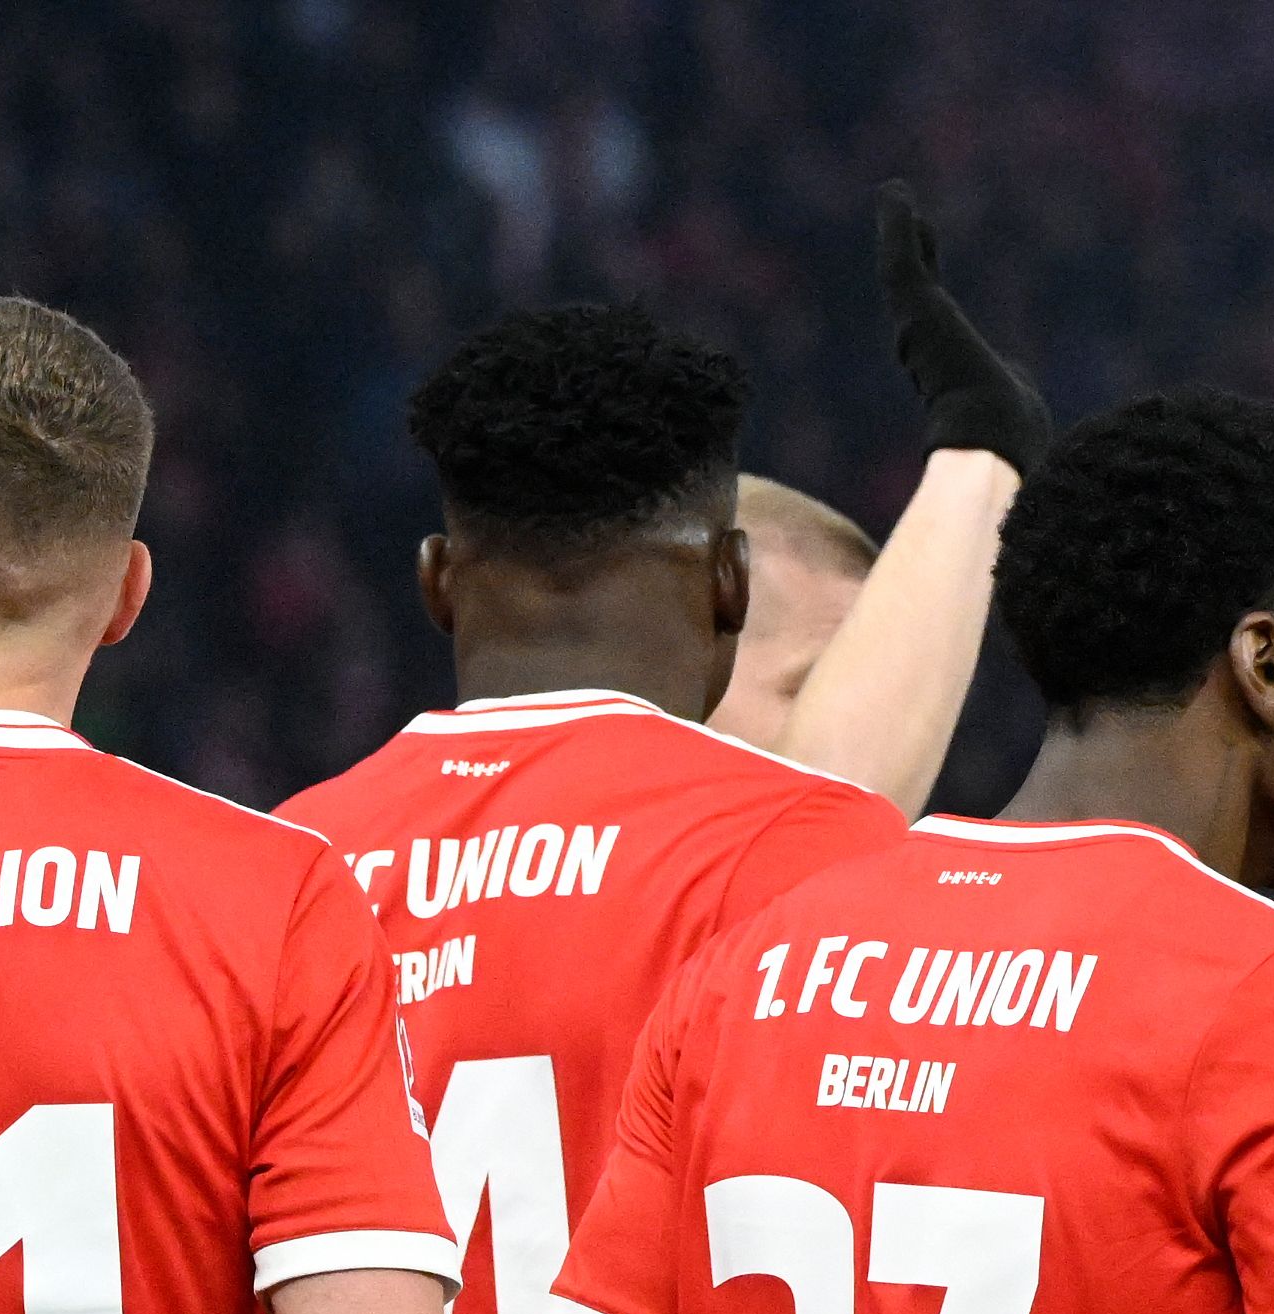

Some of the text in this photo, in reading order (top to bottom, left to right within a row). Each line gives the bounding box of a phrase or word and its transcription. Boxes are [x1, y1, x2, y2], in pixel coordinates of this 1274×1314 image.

[406, 823, 621, 919] UNION
[392, 934, 477, 1007] RLIN
[753, 935, 1099, 1033] 1. FC UNION
[816, 1053, 957, 1114] BERLIN
